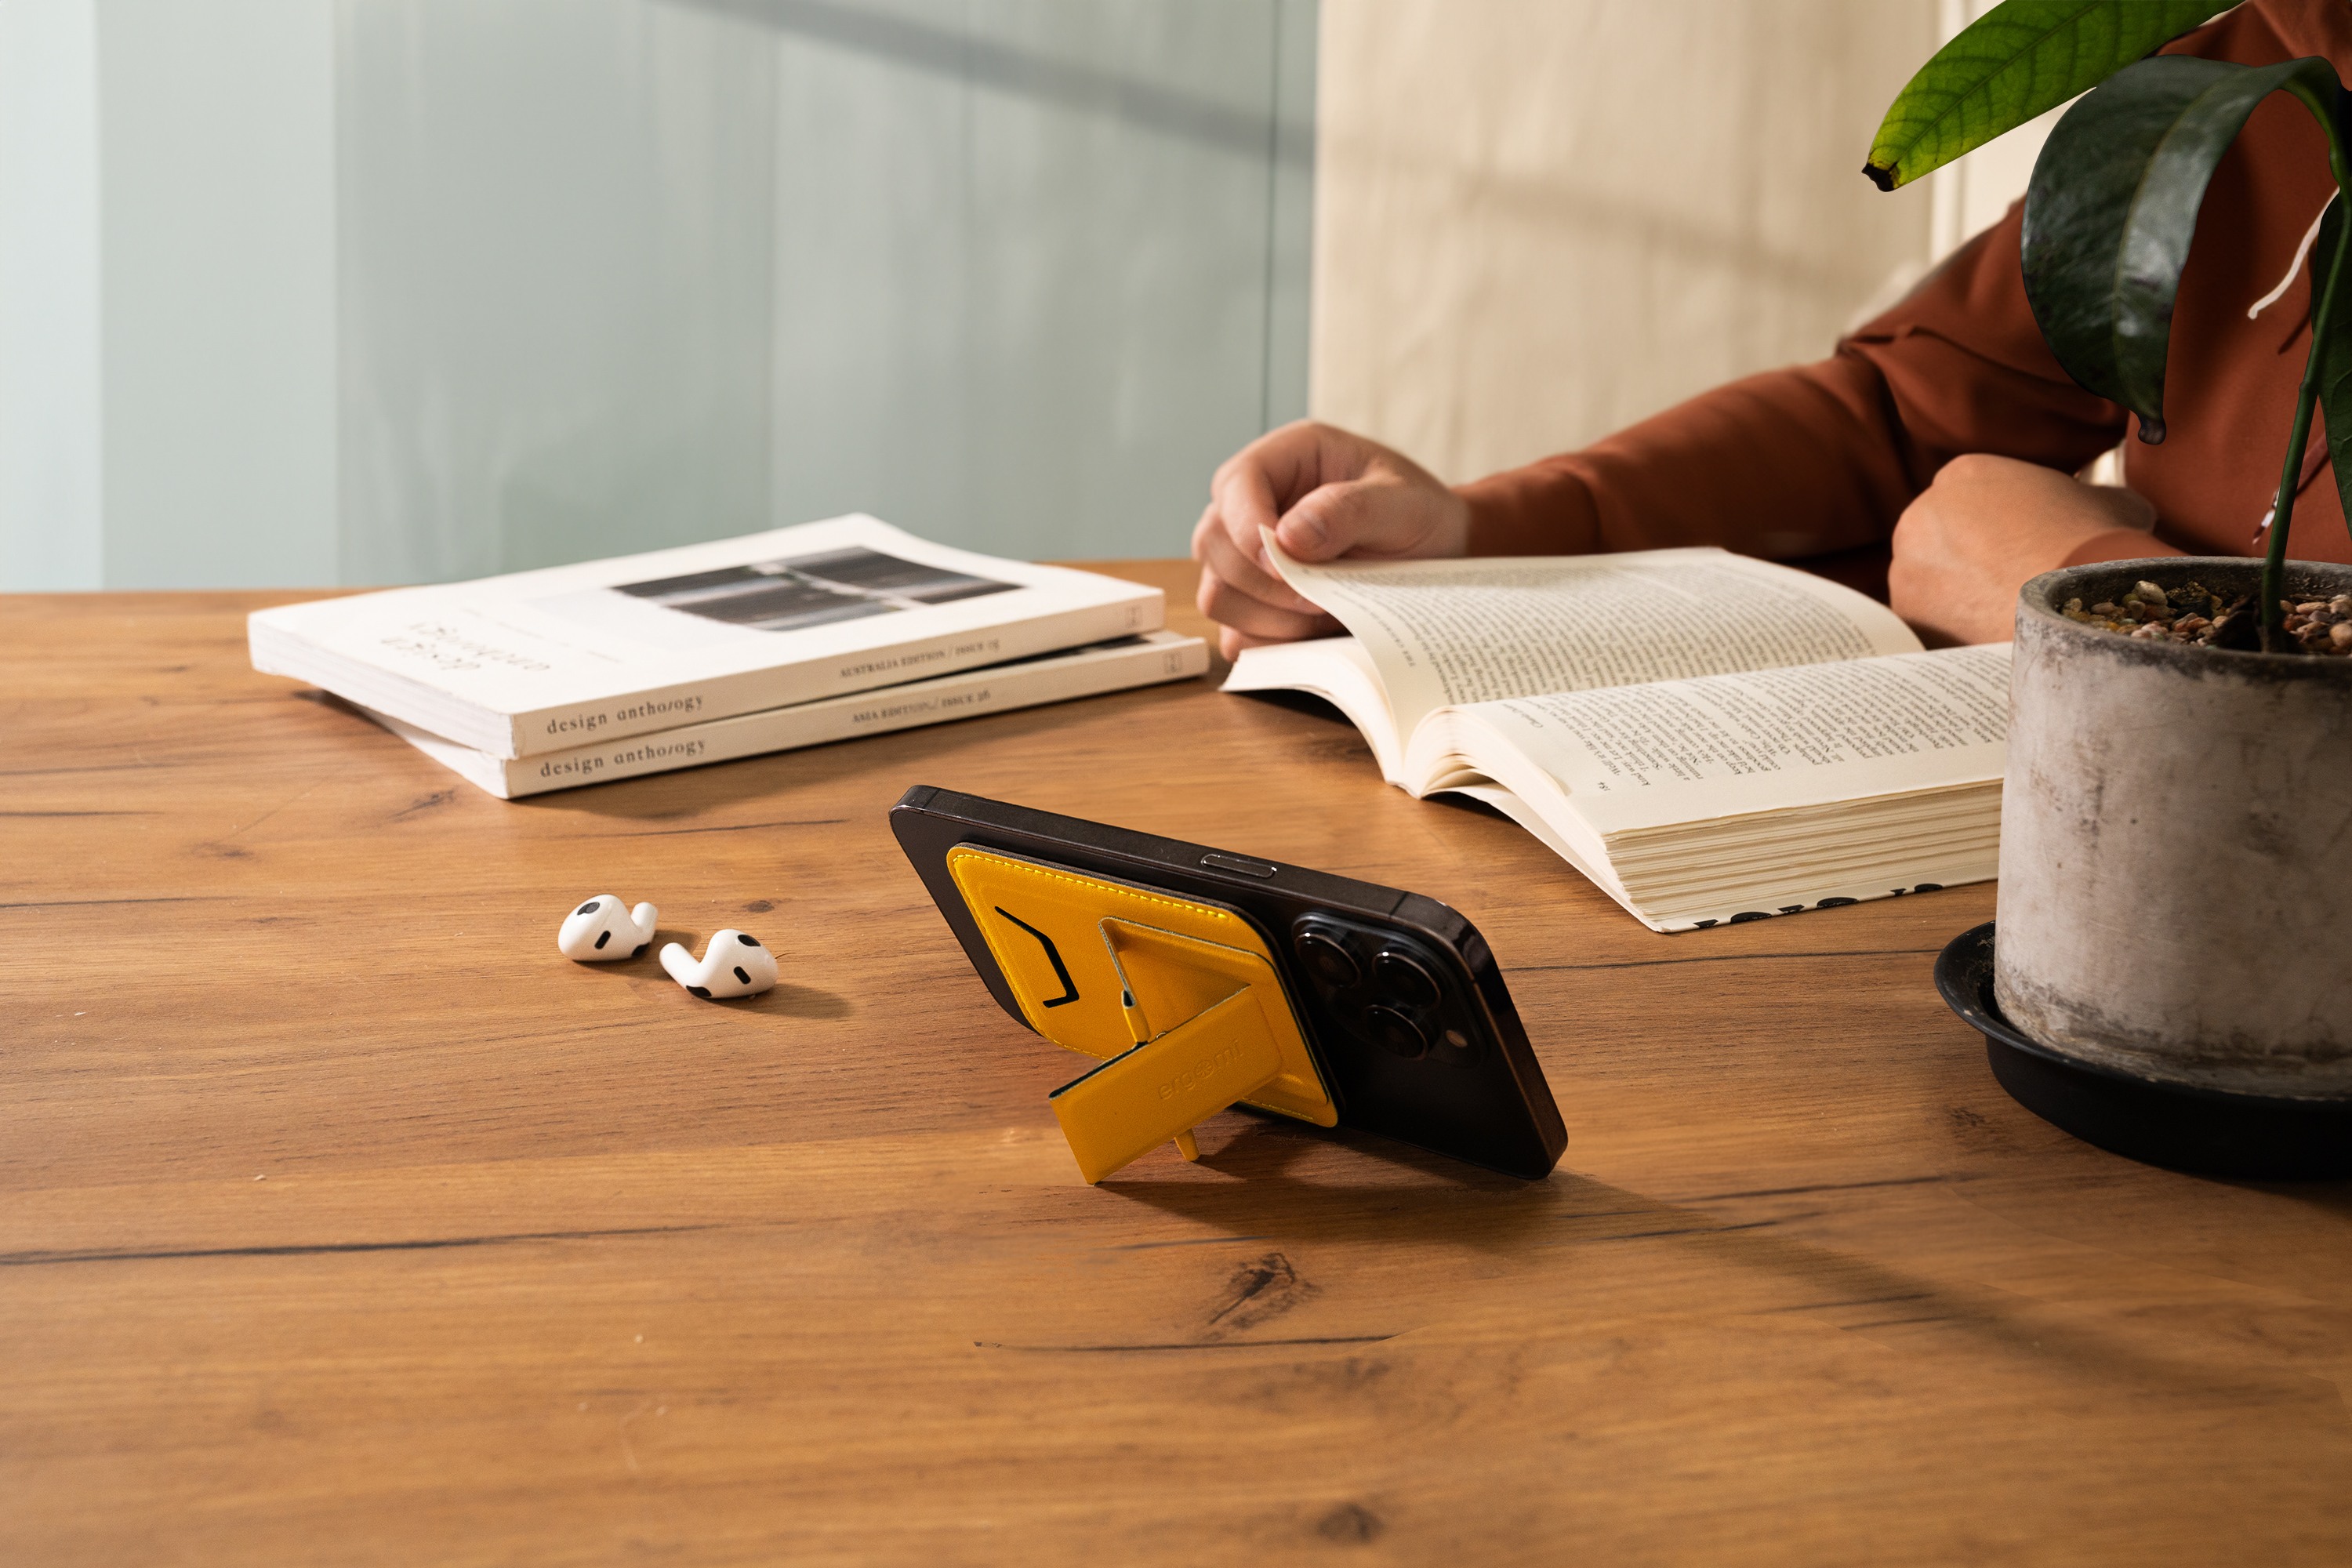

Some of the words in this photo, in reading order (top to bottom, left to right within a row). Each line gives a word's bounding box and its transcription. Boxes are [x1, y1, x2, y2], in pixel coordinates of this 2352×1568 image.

[546, 713, 608, 735] design
[616, 695, 702, 722] anthology
[539, 757, 604, 778] design
[614, 739, 705, 765] anthology
[1597, 782, 1611, 791] 184
